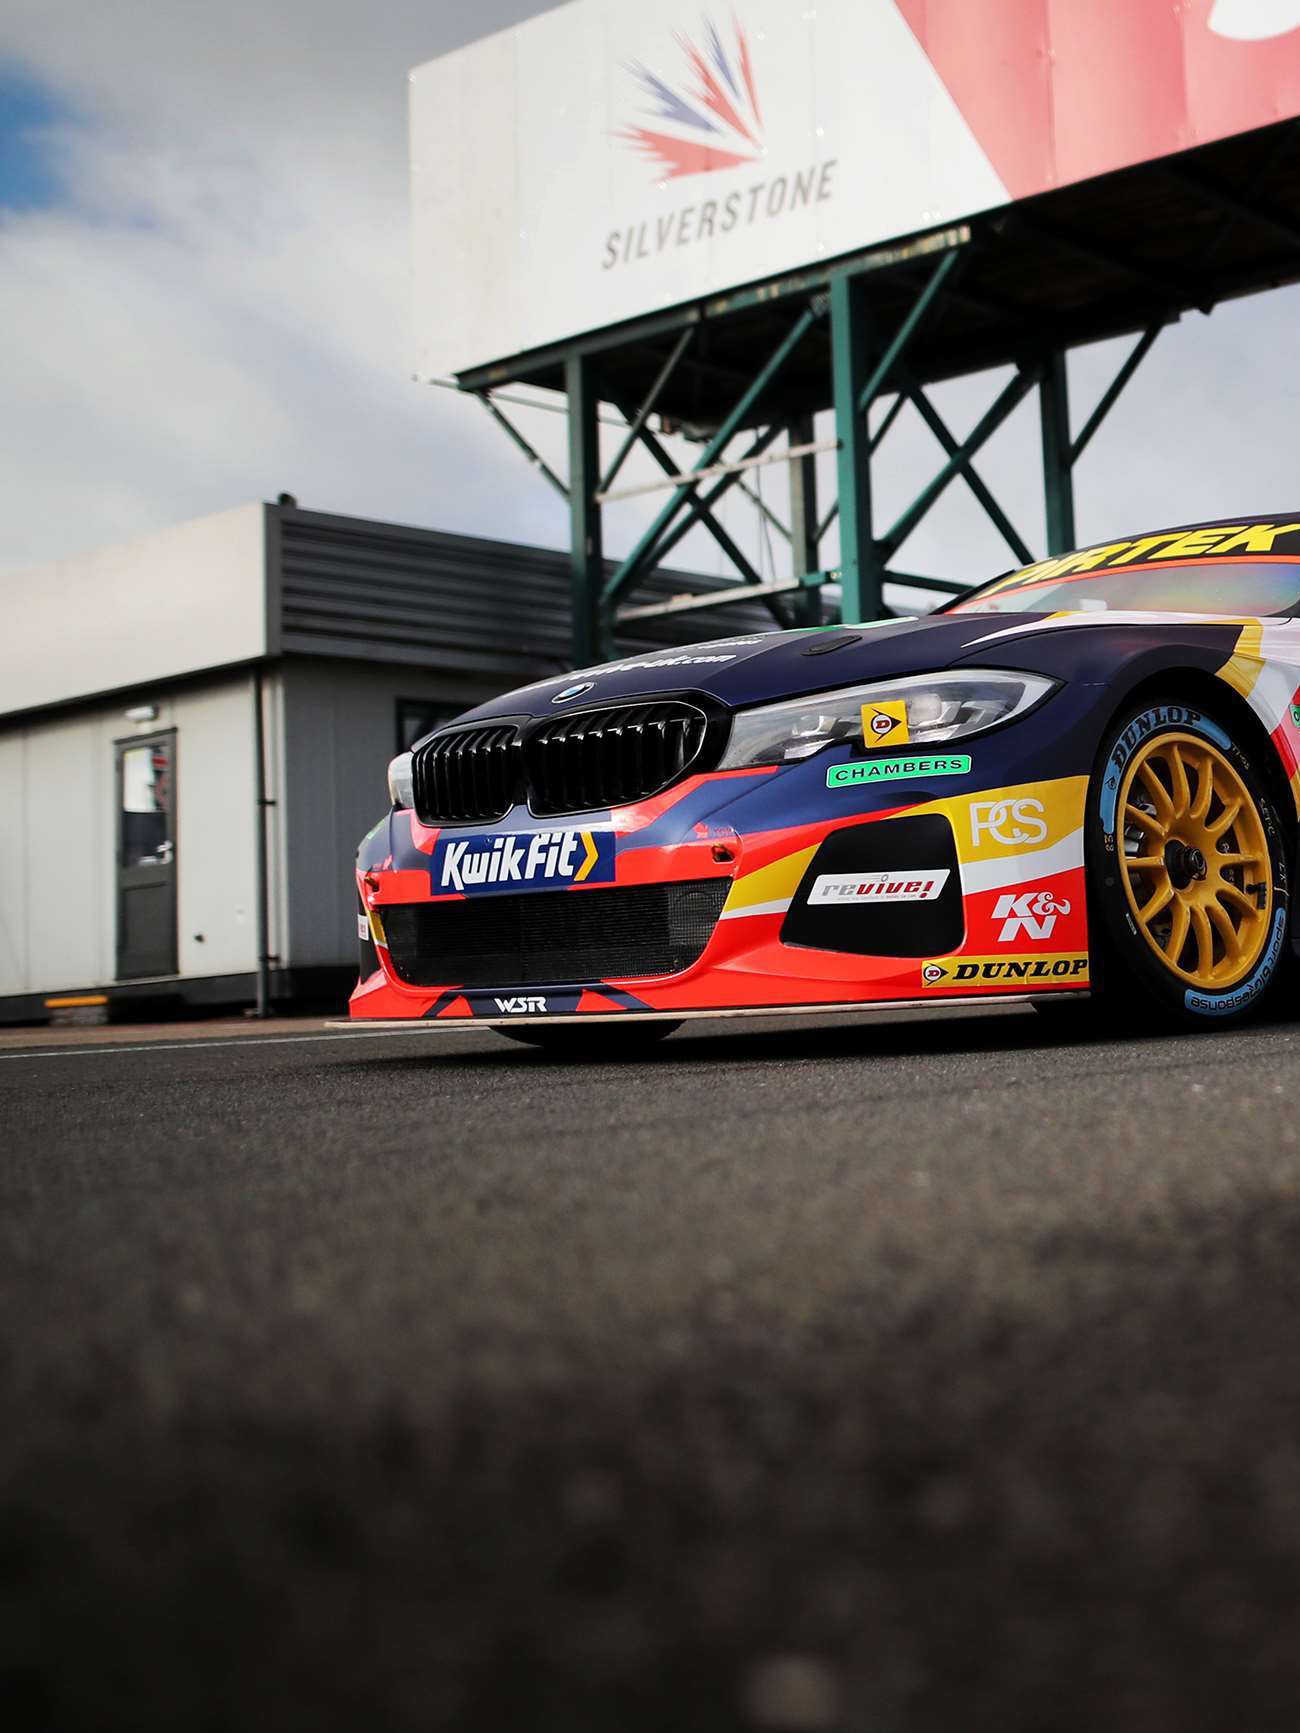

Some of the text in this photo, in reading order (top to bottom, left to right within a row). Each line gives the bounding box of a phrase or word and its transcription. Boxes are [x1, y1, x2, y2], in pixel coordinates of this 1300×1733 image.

[601, 159, 837, 270] SILVERSTONE
[1113, 706, 1201, 770] DUNLOP
[835, 759, 963, 782] CHAMBERS
[822, 880, 935, 899] revive!
[952, 958, 1088, 981] DUNLOP
[494, 996, 548, 1013] WSR
